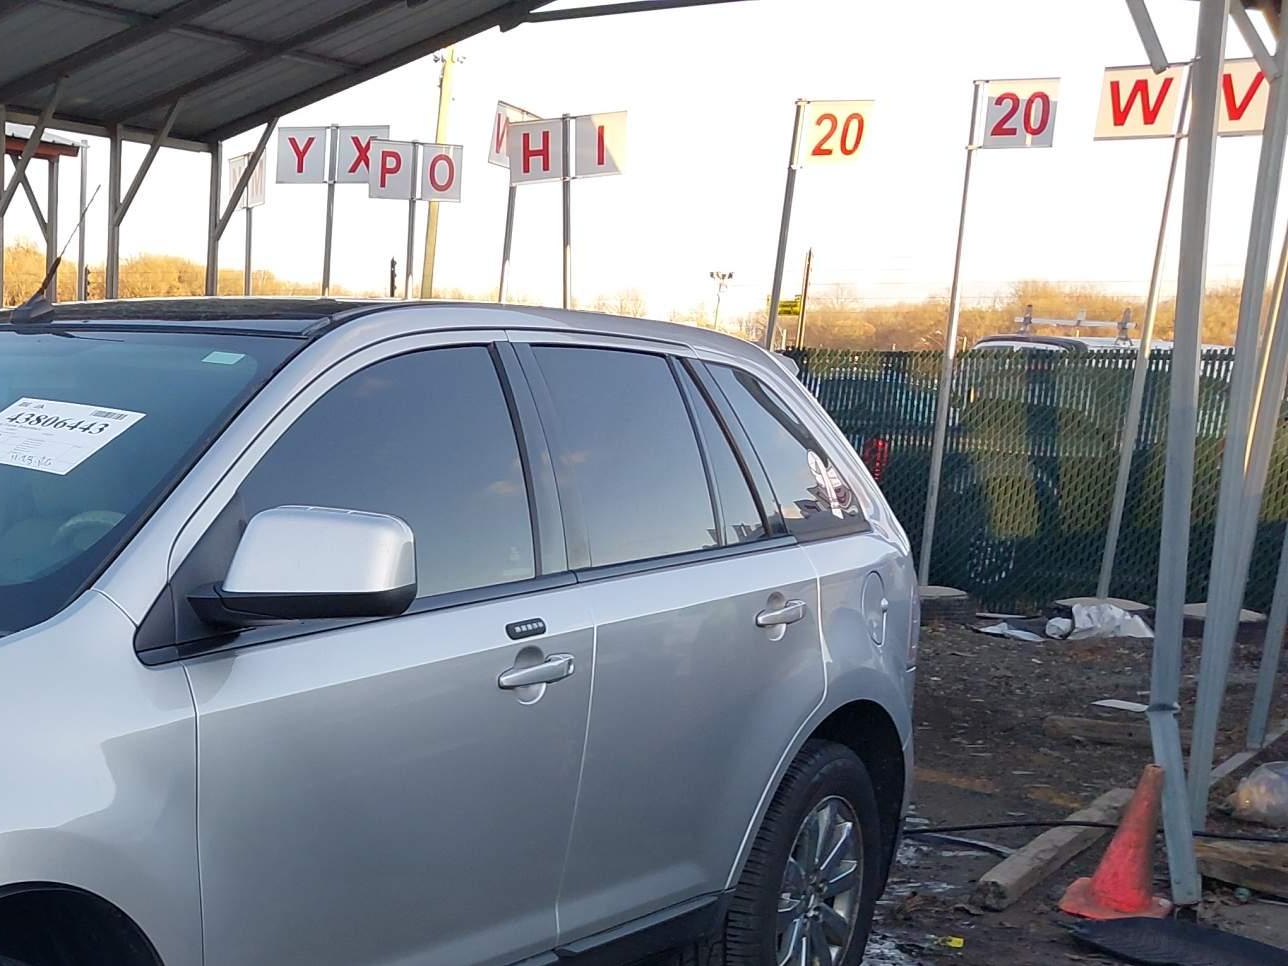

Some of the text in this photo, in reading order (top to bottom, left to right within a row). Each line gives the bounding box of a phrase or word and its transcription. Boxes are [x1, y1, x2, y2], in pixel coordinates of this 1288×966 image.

[990, 91, 1050, 137] 20
[1110, 70, 1266, 127] W V
[288, 136, 375, 174] Y X
[521, 129, 550, 174] H
[597, 124, 605, 165] I
[811, 112, 865, 156] 20
[379, 150, 456, 193] P O
[7, 412, 110, 435] 43806443
